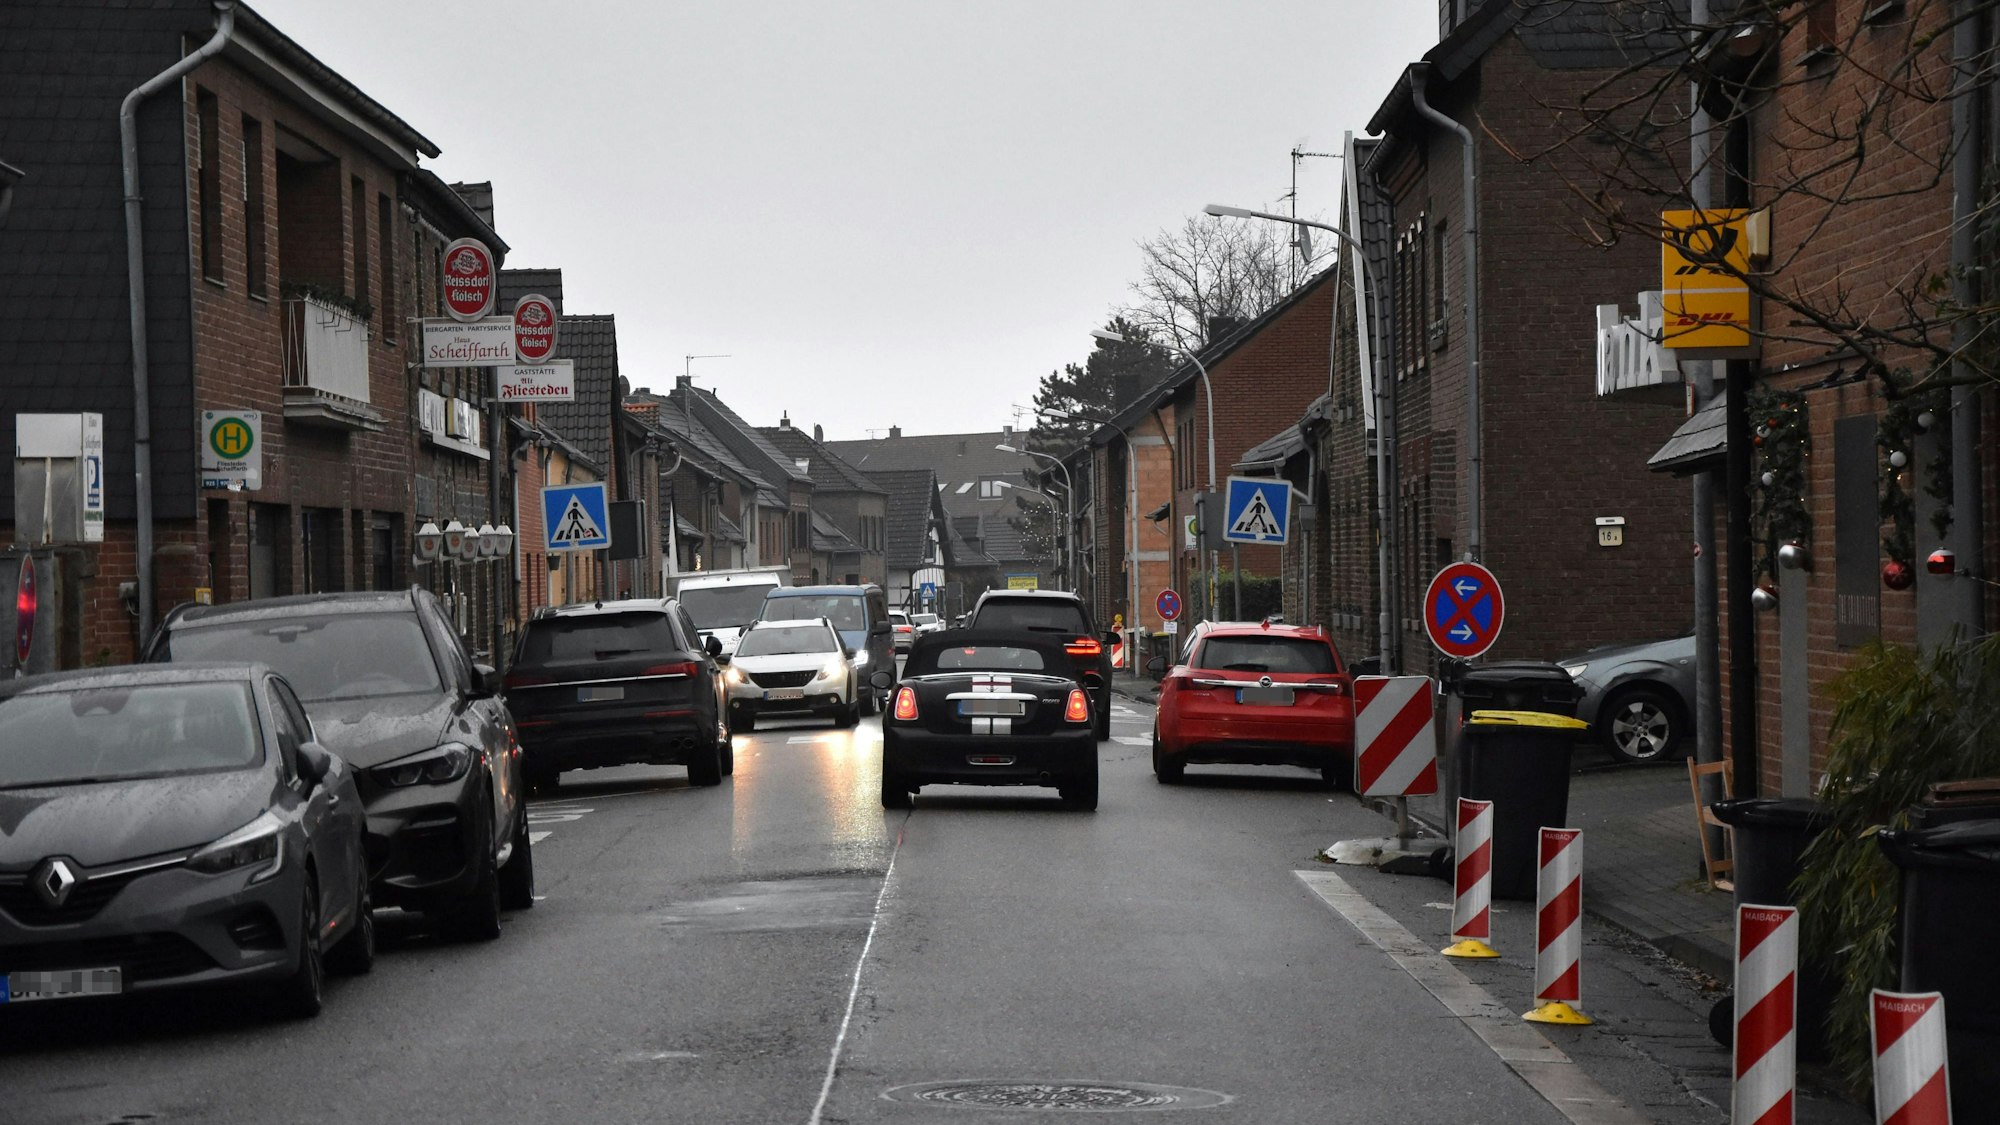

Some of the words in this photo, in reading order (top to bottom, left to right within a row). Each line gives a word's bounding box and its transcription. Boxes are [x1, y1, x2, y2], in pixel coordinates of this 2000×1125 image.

[445, 274, 489, 287] Reissdorf
[452, 289, 483, 302] Kölsch
[1677, 312, 1737, 326] DHL
[516, 324, 553, 335] Reissdorf
[429, 341, 510, 362] Scheiffarth
[502, 384, 569, 399] Fliesteden
[223, 426, 241, 450] H
[1544, 832, 1573, 841] MAIBACH
[1745, 911, 1784, 922] MAIBACH
[1880, 1001, 1926, 1013] MAIBACH
